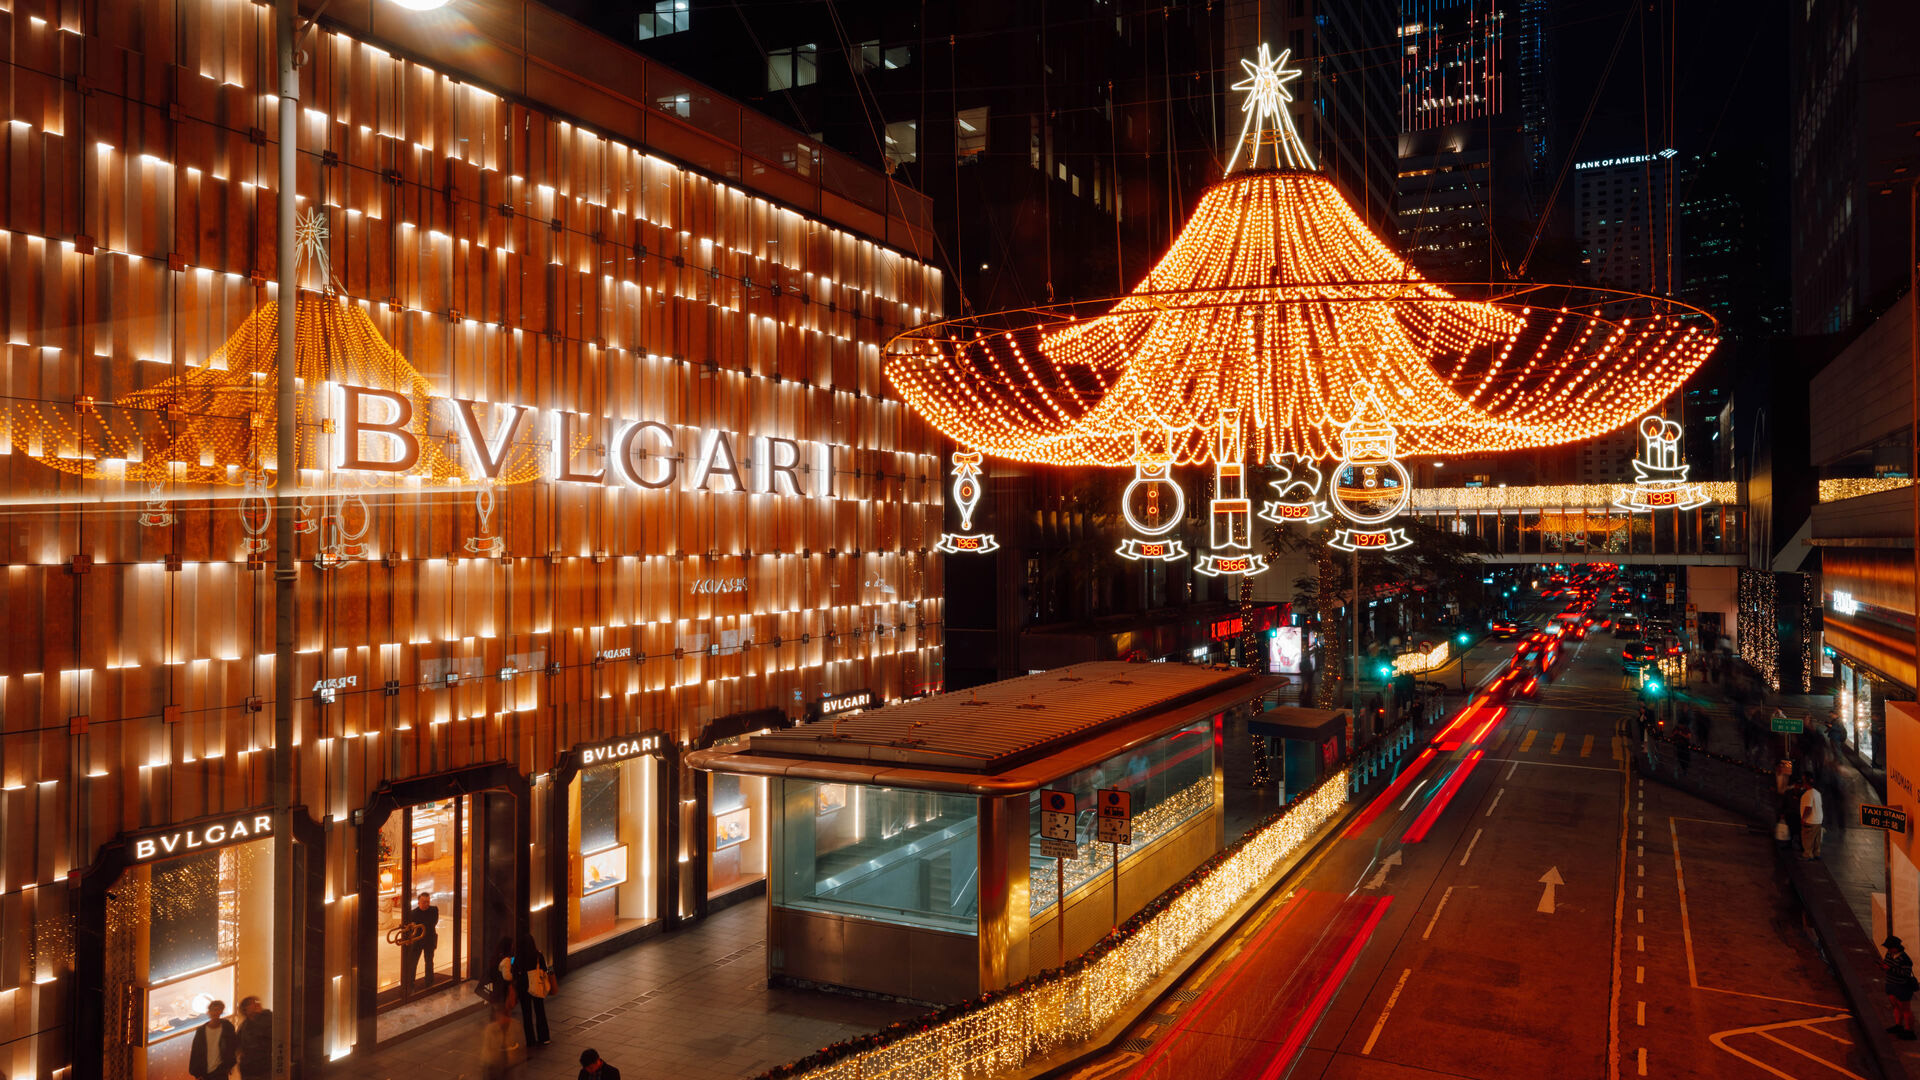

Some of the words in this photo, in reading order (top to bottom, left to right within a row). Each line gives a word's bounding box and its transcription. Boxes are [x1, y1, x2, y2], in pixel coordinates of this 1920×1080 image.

[1575, 161, 1600, 170] BANK
[1615, 154, 1657, 165] AMERICA
[337, 384, 836, 497] BVLGARI
[1647, 492, 1676, 505] 1981
[1279, 504, 1309, 518] 1982
[956, 538, 979, 549] 1965
[1355, 532, 1388, 547] 1978
[1141, 543, 1164, 556] 1981
[1217, 558, 1245, 571] 1966
[823, 694, 870, 713] BVLGARI
[583, 736, 660, 764] BVLGARI
[1064, 816, 1069, 825] 7
[1863, 807, 1881, 816] TAXI
[1883, 810, 1905, 821] STAND
[1118, 821, 1124, 829] 7
[136, 815, 273, 859] BVLGAR
[1064, 830, 1069, 838] 7
[1119, 834, 1129, 843] 12
